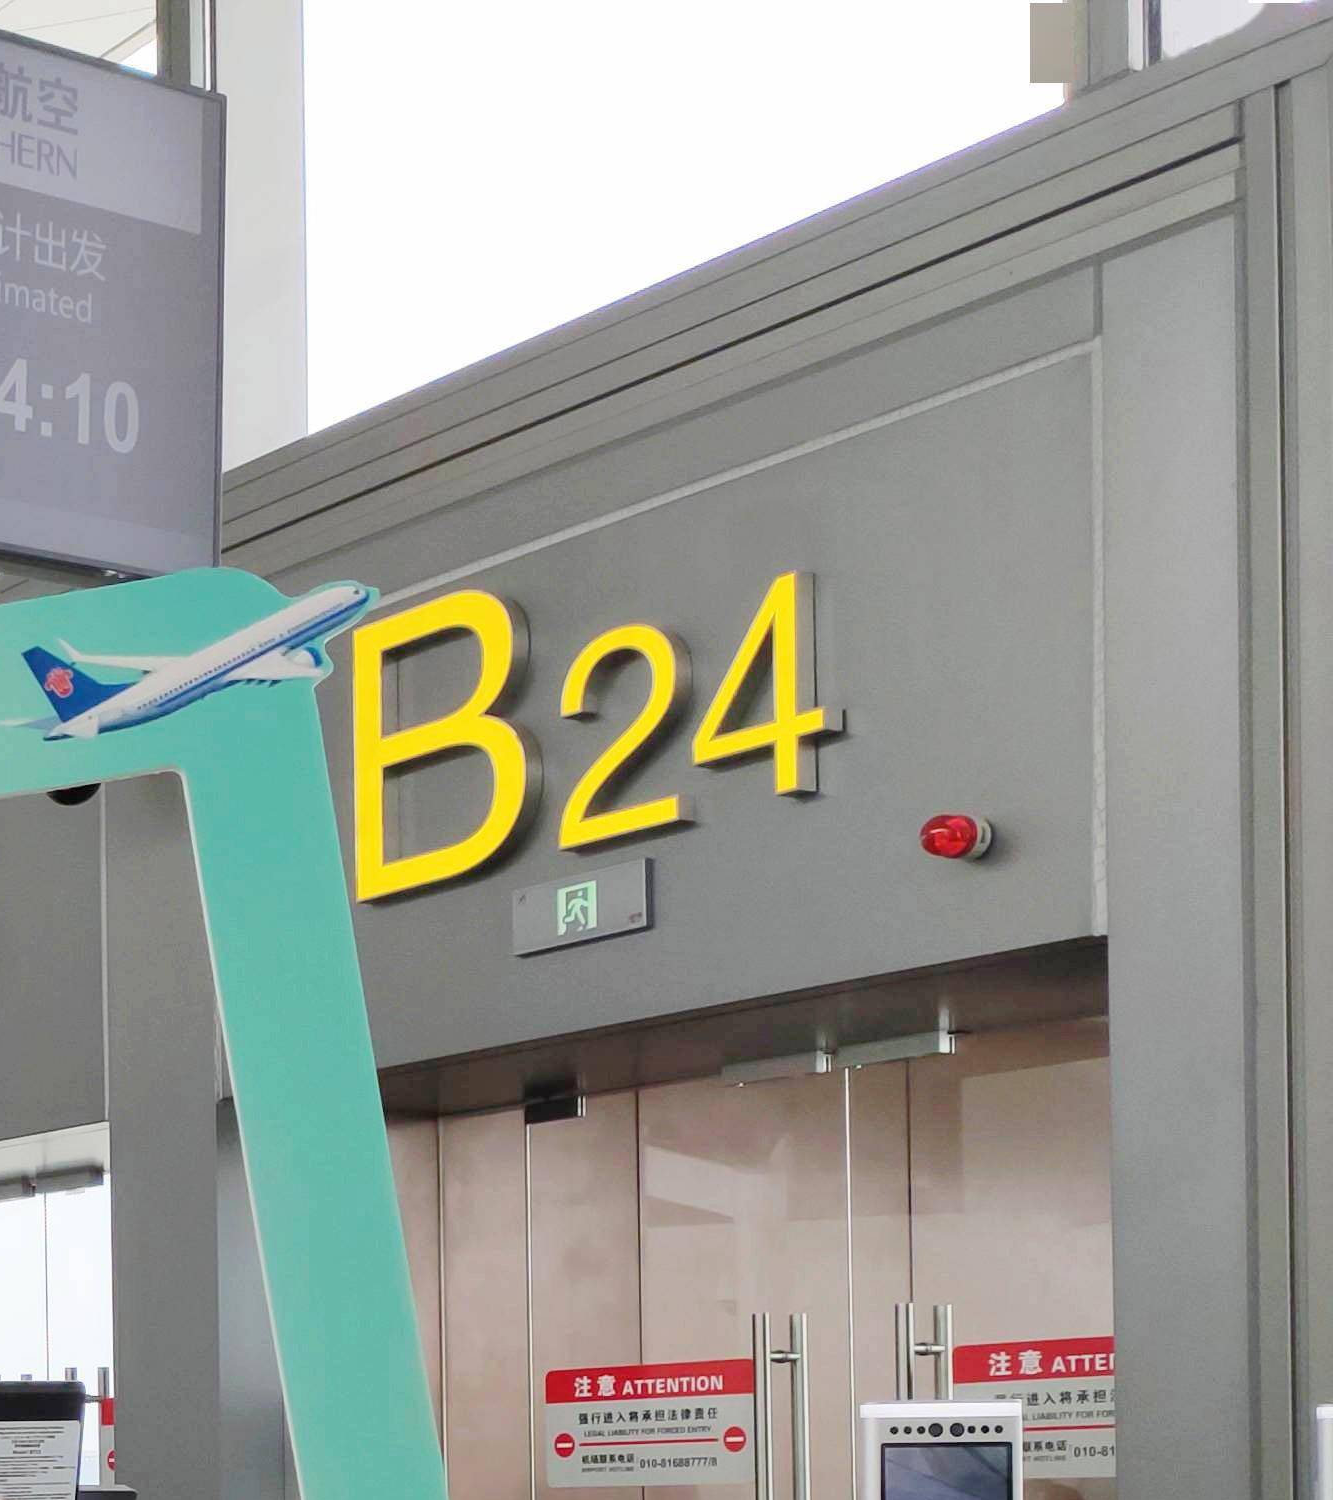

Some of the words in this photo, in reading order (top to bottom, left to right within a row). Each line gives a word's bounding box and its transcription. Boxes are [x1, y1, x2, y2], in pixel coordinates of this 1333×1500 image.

[352, 570, 829, 904] B24
[989, 1349, 1042, 1377] 注意
[574, 1375, 617, 1397] 注意
[622, 1375, 724, 1396] ATTENTION
